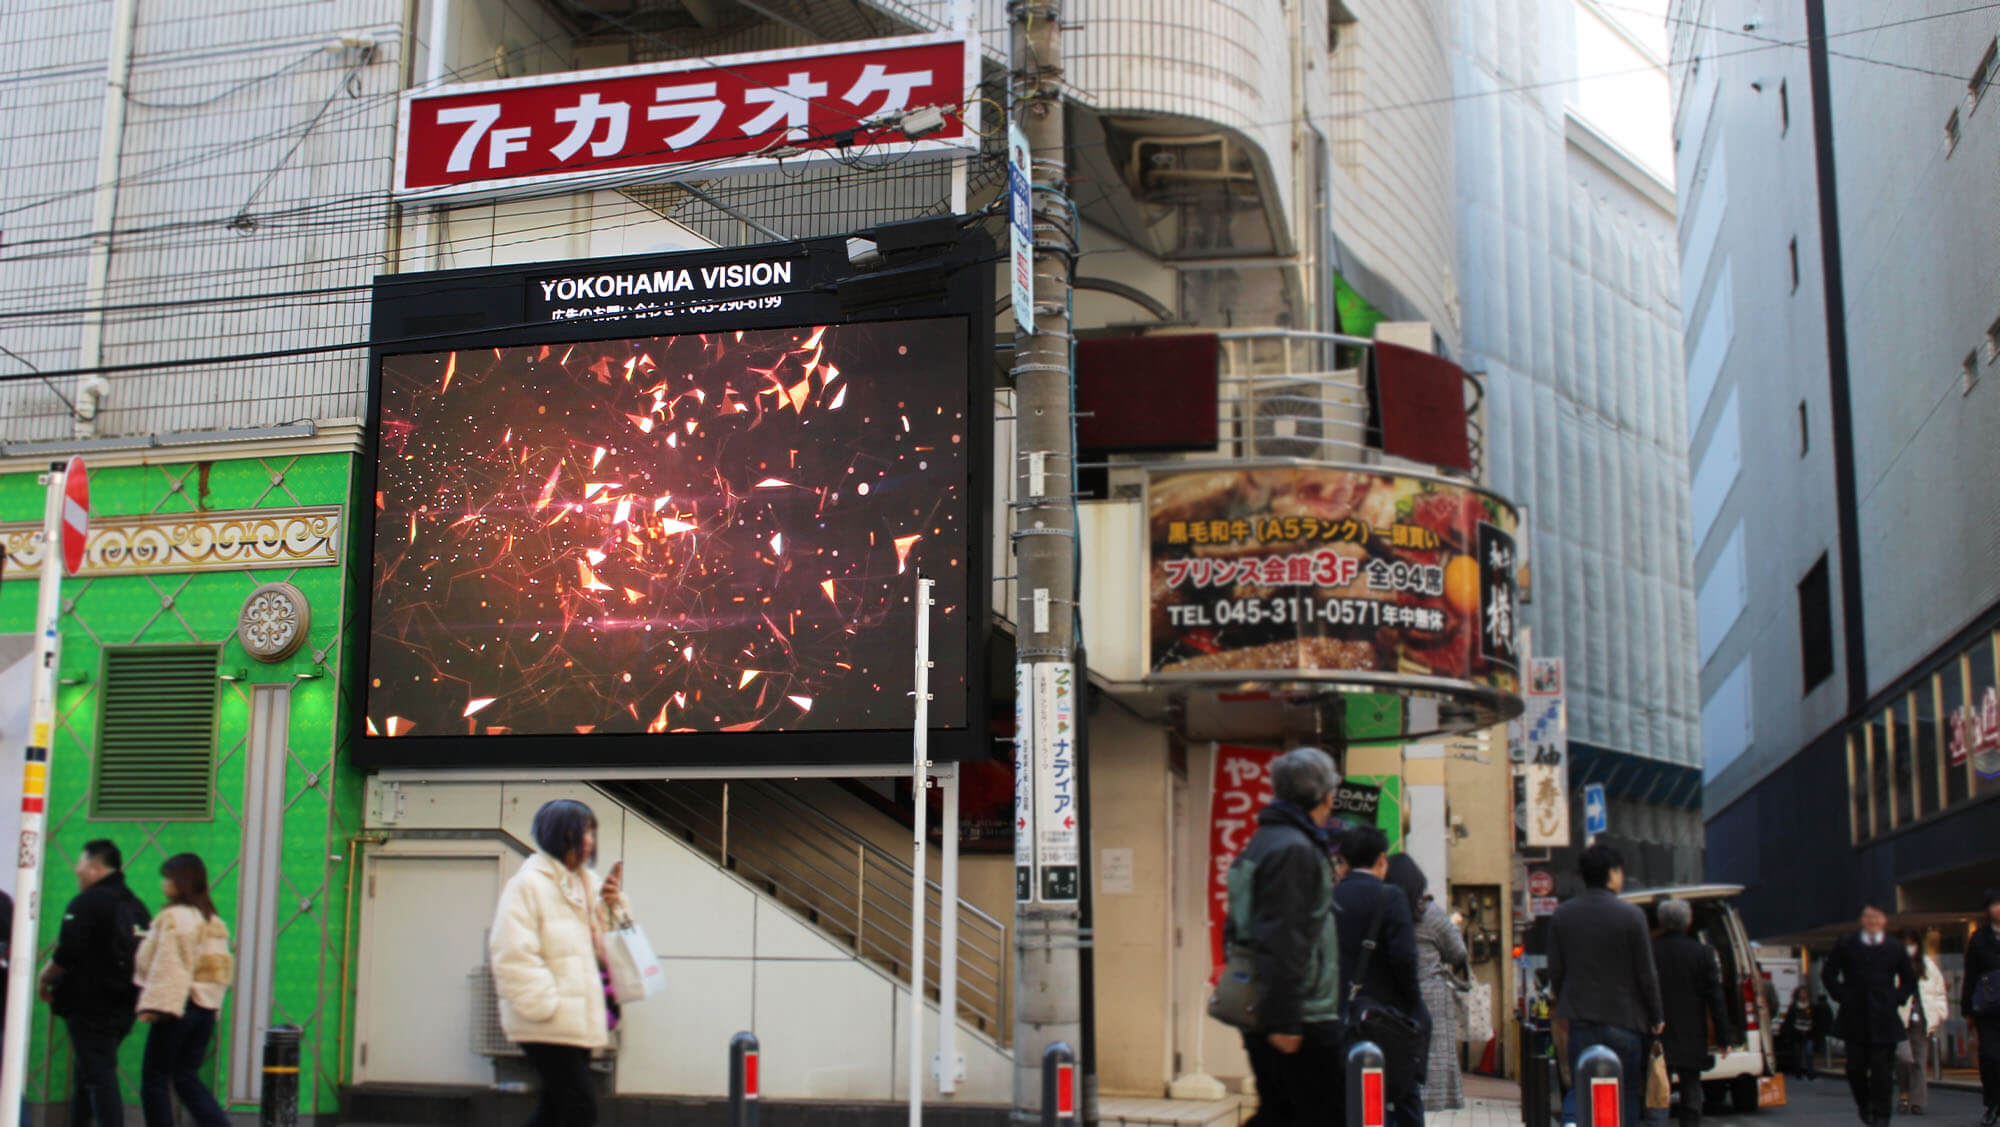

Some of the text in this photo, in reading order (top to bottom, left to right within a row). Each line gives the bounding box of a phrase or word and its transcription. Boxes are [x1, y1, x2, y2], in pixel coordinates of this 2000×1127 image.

[436, 64, 933, 172] 7F カラオケ
[540, 261, 791, 301] YOKOHAMA VISION
[1168, 605, 1211, 626] TEL
[1215, 598, 1381, 625] 045-311-0571
